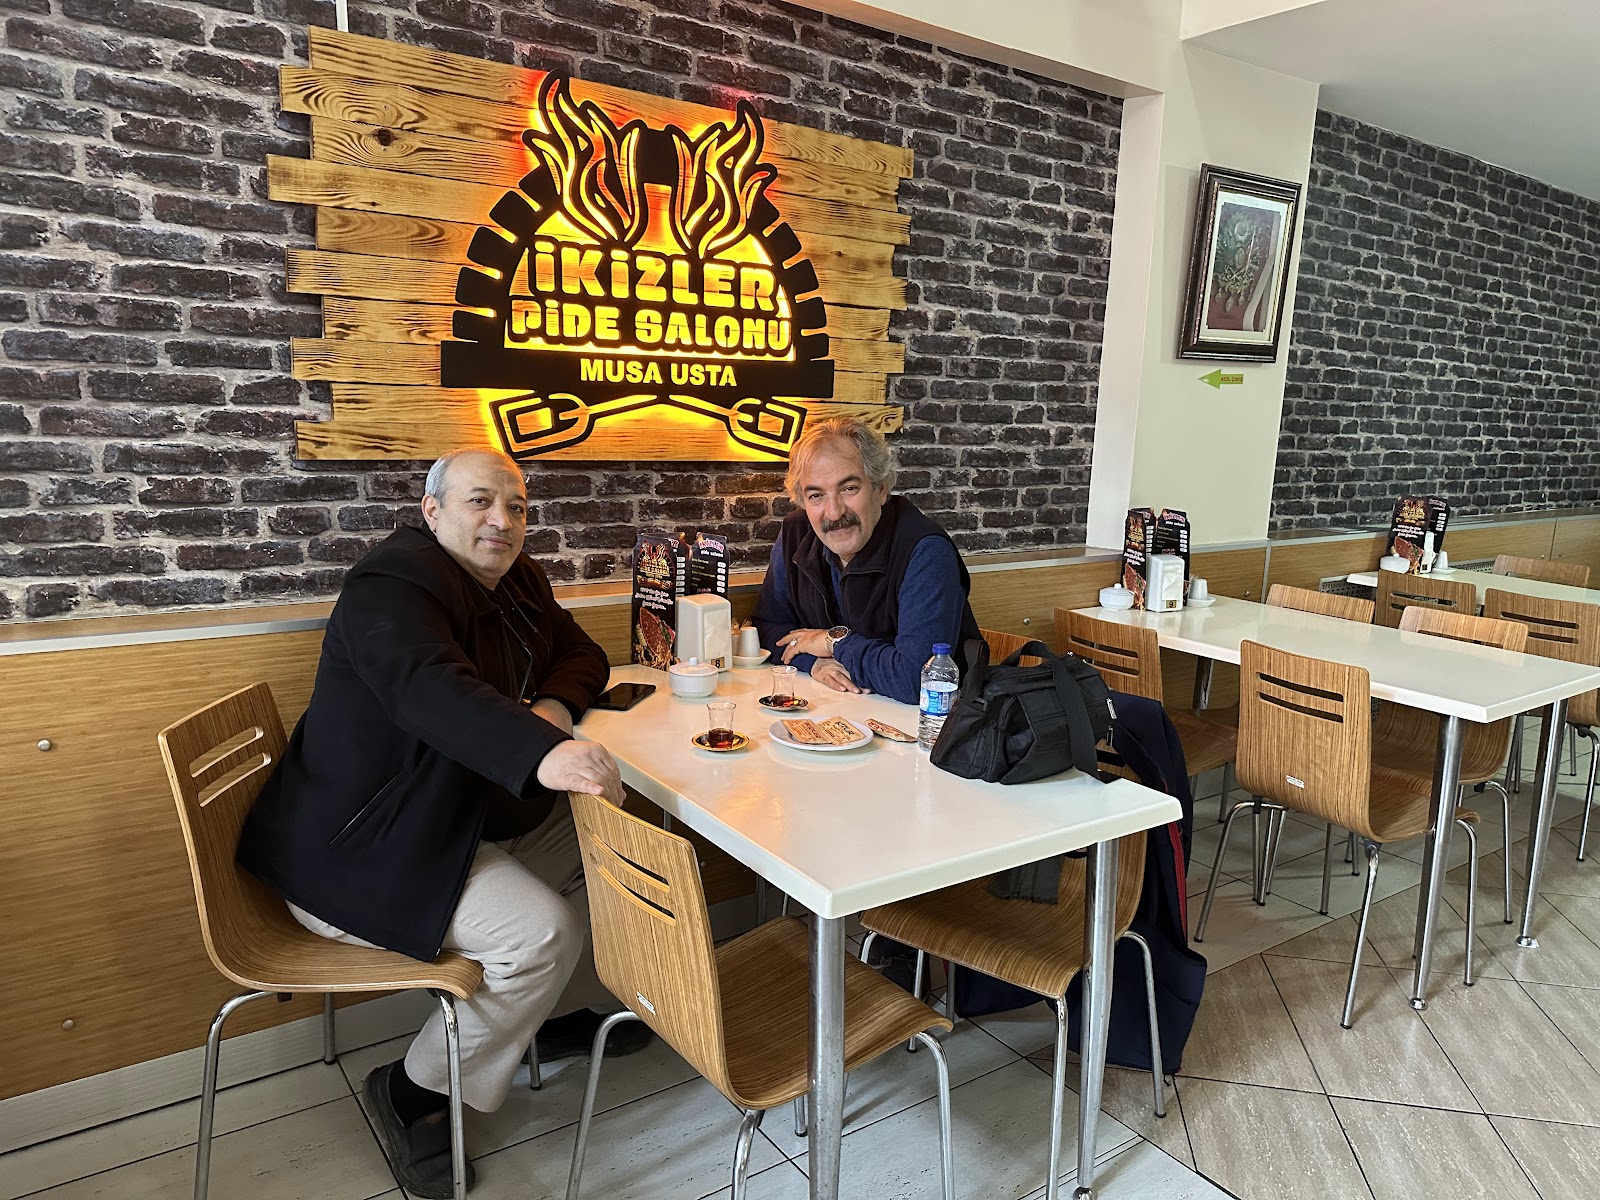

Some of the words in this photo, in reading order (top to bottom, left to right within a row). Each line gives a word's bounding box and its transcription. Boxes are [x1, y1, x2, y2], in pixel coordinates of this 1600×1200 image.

[534, 240, 776, 312] İKİZLER
[511, 299, 620, 341] PİDE
[634, 308, 791, 351] SALONU
[580, 358, 664, 385] MUSA
[670, 362, 738, 387] USTA
